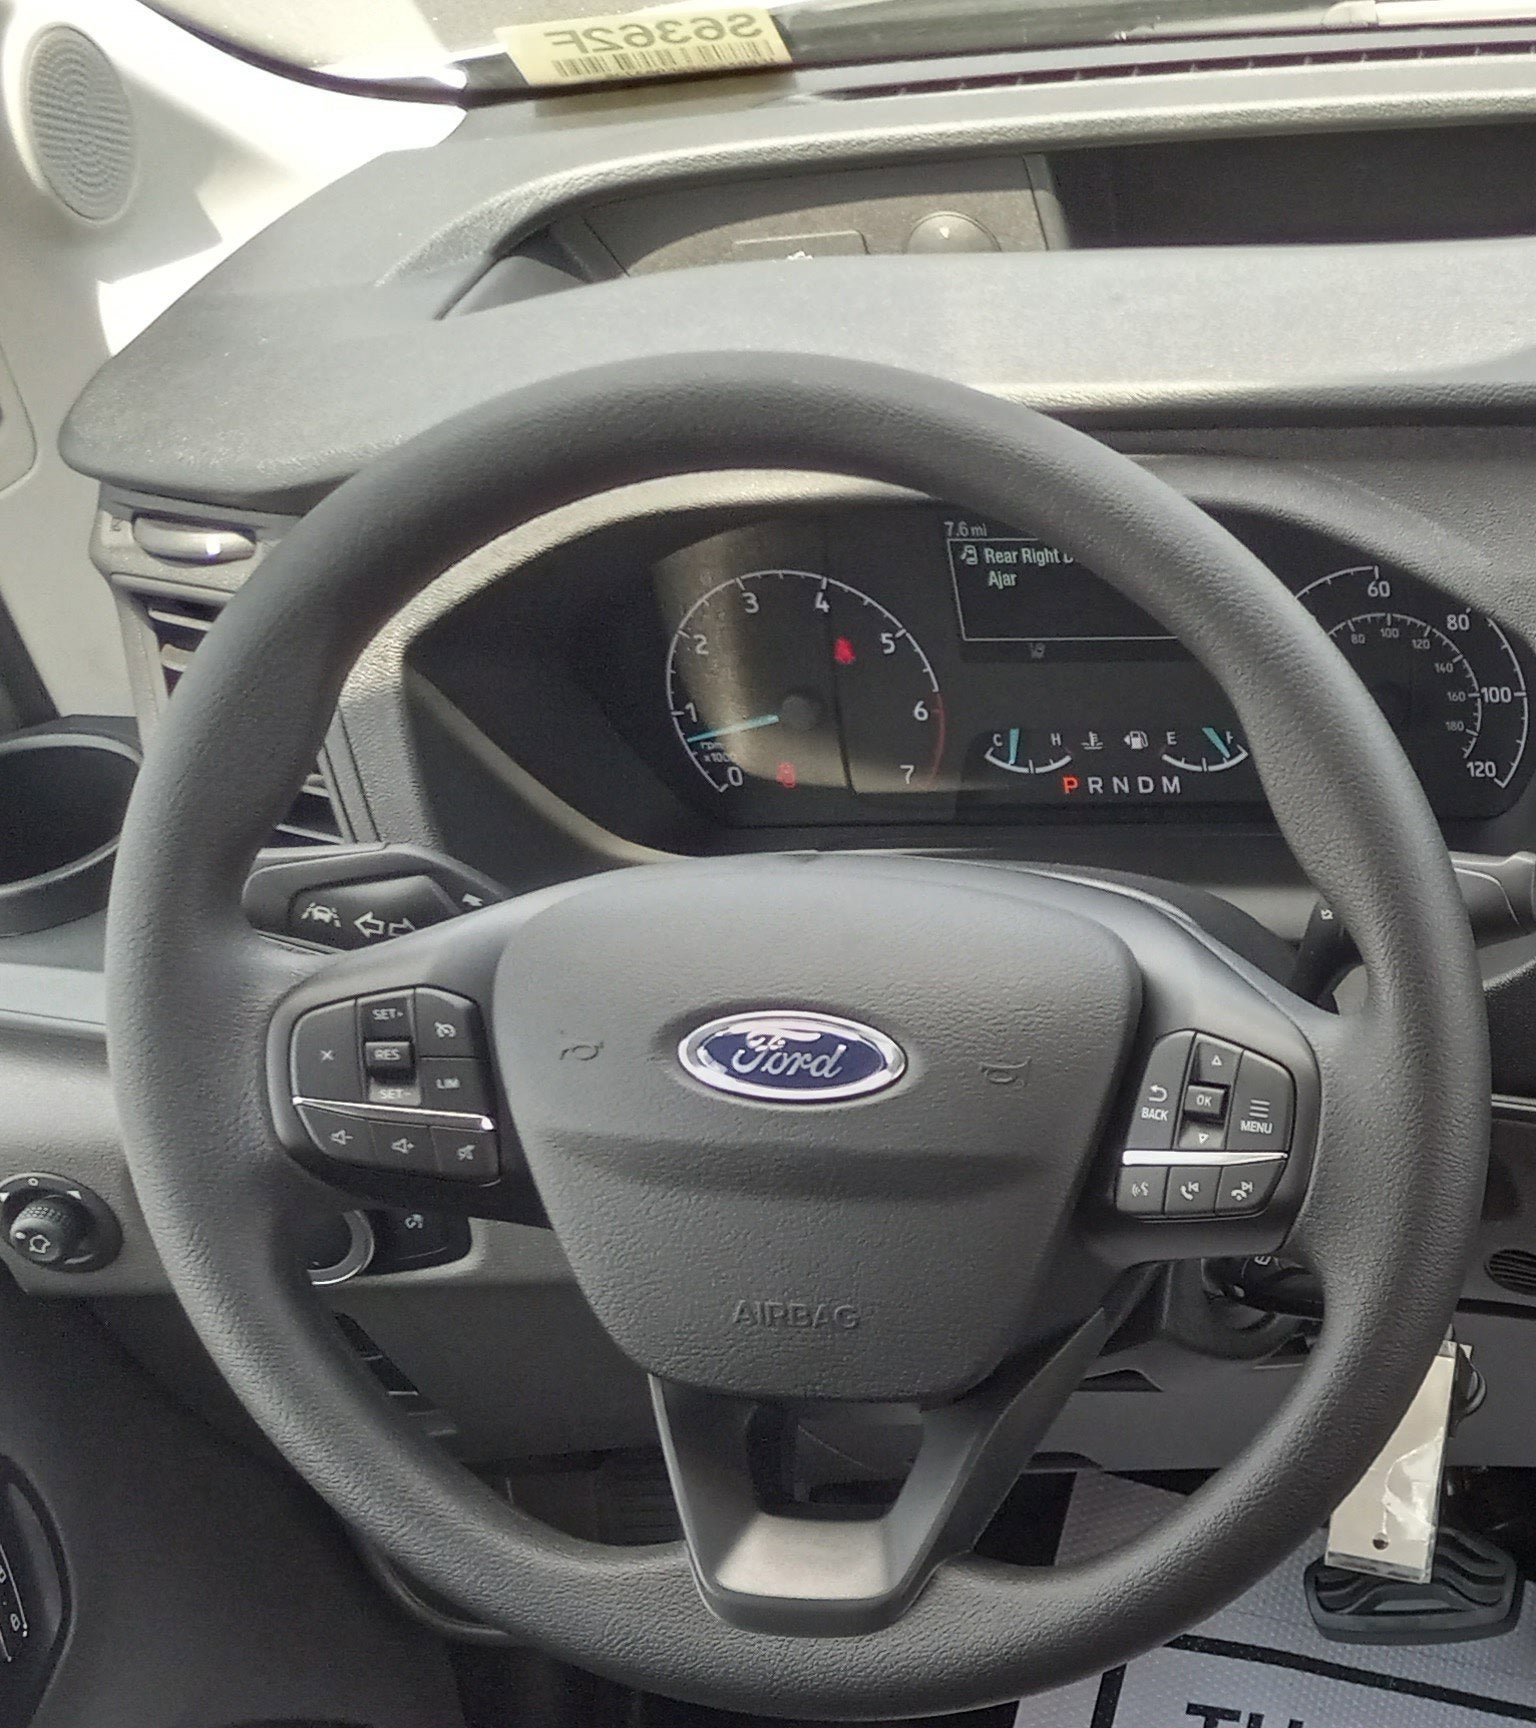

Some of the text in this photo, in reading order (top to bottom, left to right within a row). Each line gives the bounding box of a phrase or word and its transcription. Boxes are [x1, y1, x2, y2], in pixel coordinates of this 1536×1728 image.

[944, 521, 987, 537] 7.6 mi
[985, 548, 1018, 564] Rear
[1022, 547, 1060, 567] Right
[988, 570, 1017, 589] Ajar
[1367, 581, 1391, 598] 60
[742, 592, 760, 613] 3
[815, 592, 830, 613] 4
[1446, 613, 1470, 631] 80
[1351, 633, 1366, 644] 80
[1380, 627, 1399, 638] 100
[693, 634, 709, 656] 2
[880, 632, 896, 654] 5
[1412, 638, 1431, 650] 120
[1434, 662, 1454, 673] 140
[1446, 690, 1466, 702] 160
[1480, 686, 1512, 703] 100
[685, 702, 698, 723] 1
[913, 701, 929, 721] 6
[1445, 720, 1465, 731] 180
[992, 733, 1003, 747] C
[1051, 732, 1062, 747] H
[1166, 731, 1178, 746] E
[727, 766, 744, 788] 0
[900, 764, 915, 785] 7
[1466, 761, 1497, 778] 120
[374, 1048, 401, 1061] RES
[730, 1027, 848, 1079] Ford
[1196, 1095, 1212, 1107] OK
[1141, 1107, 1168, 1122] BACK
[1240, 1120, 1273, 1135] MENU
[731, 1300, 861, 1329] AIRBAG
